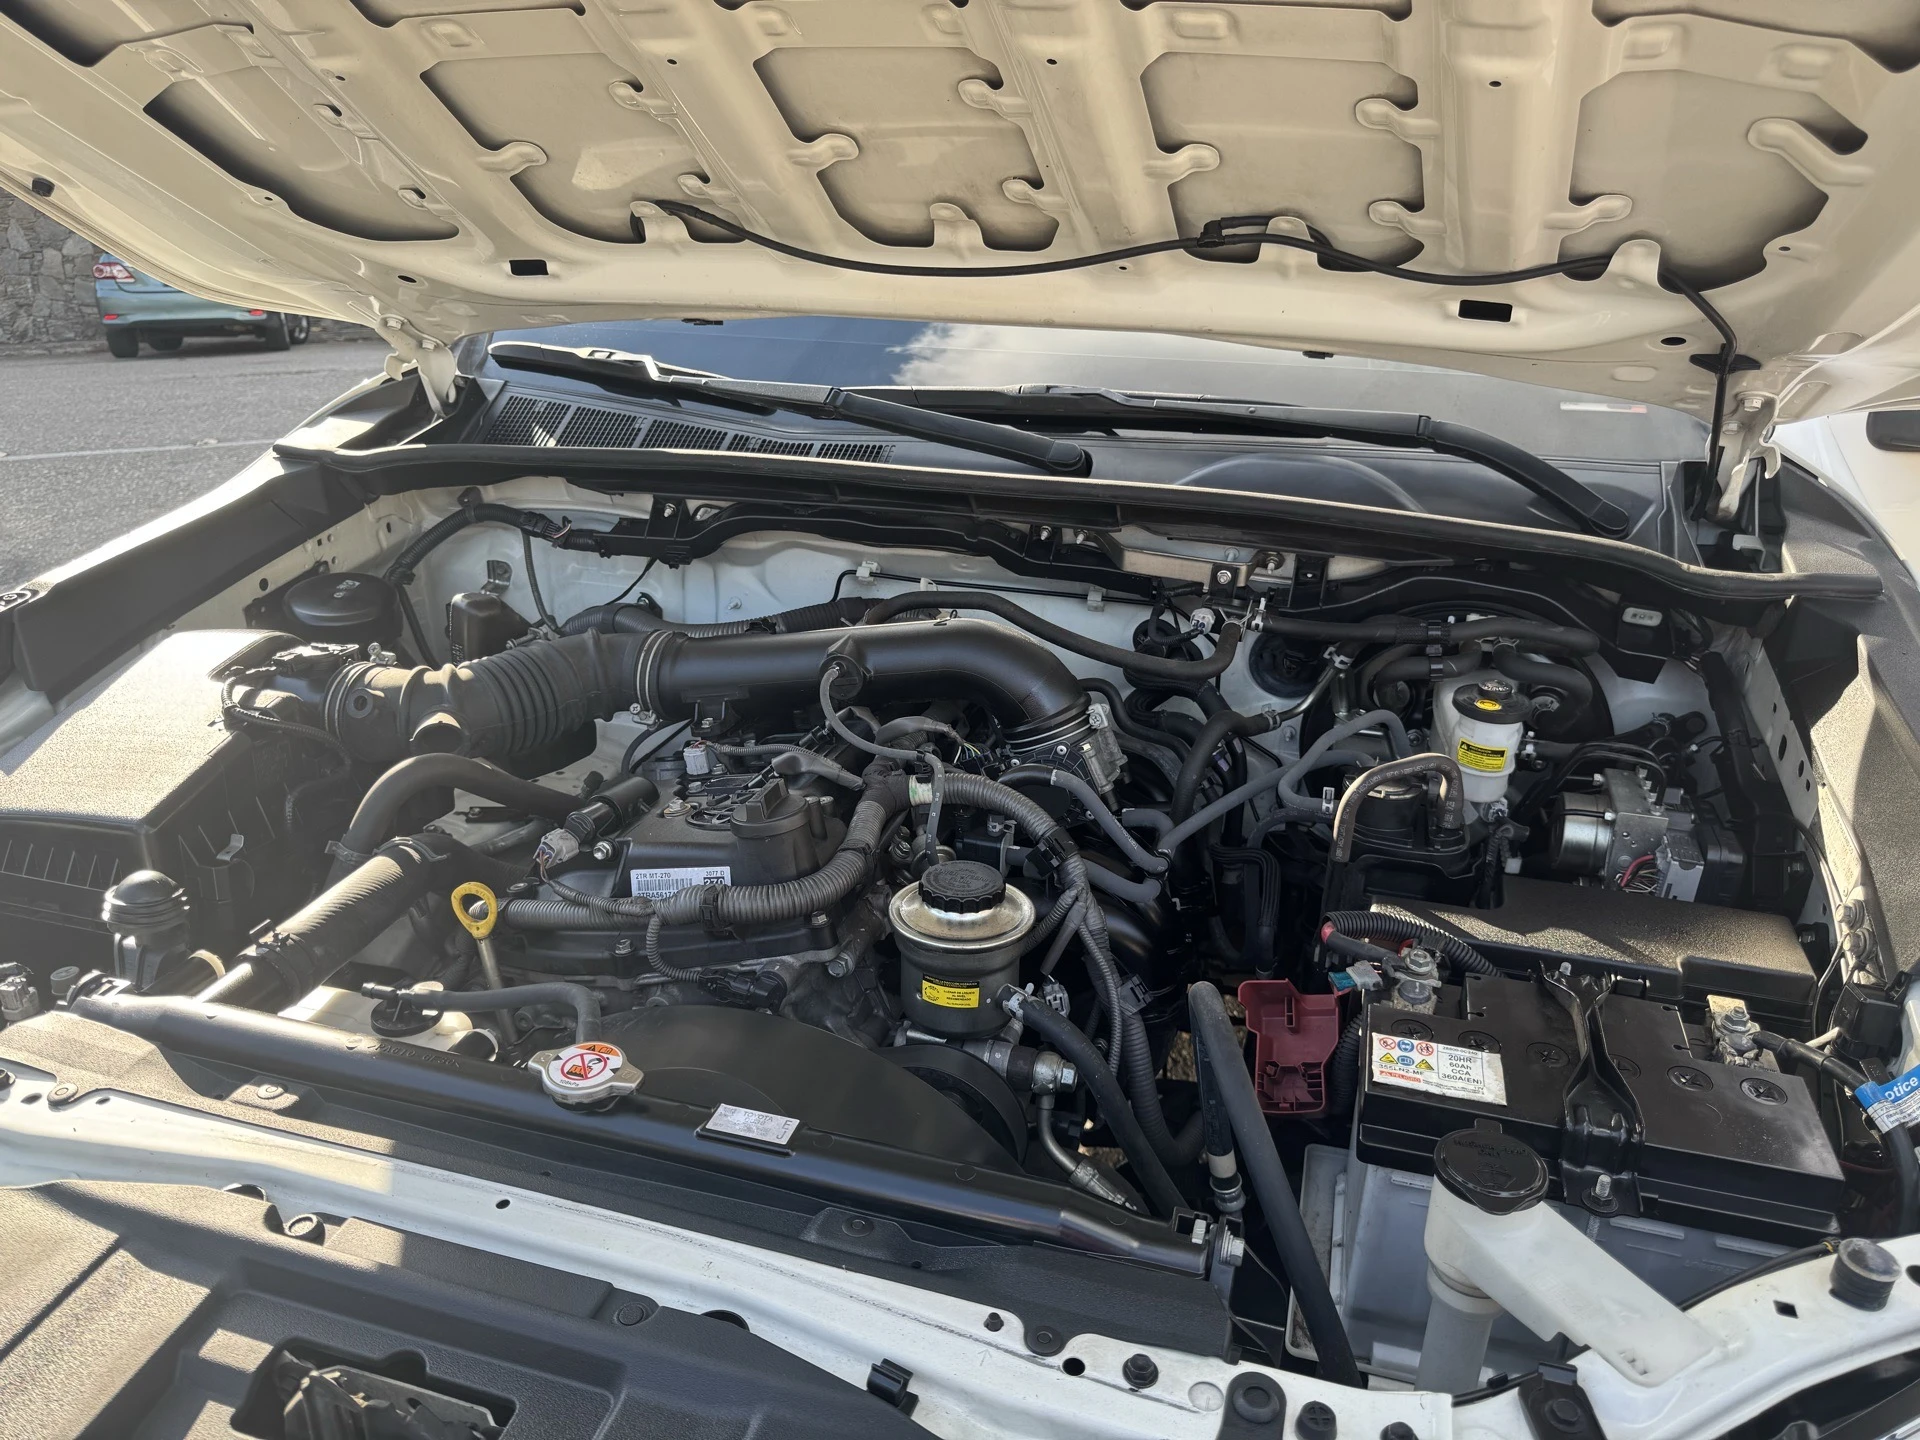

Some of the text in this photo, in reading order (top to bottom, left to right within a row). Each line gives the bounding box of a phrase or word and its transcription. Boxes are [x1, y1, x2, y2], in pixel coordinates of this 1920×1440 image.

[1448, 1054, 1472, 1064] 20HR
[1449, 1062, 1472, 1071] 60Ah
[1451, 1068, 1471, 1077] CCA
[743, 1110, 774, 1122] TOYOTA
